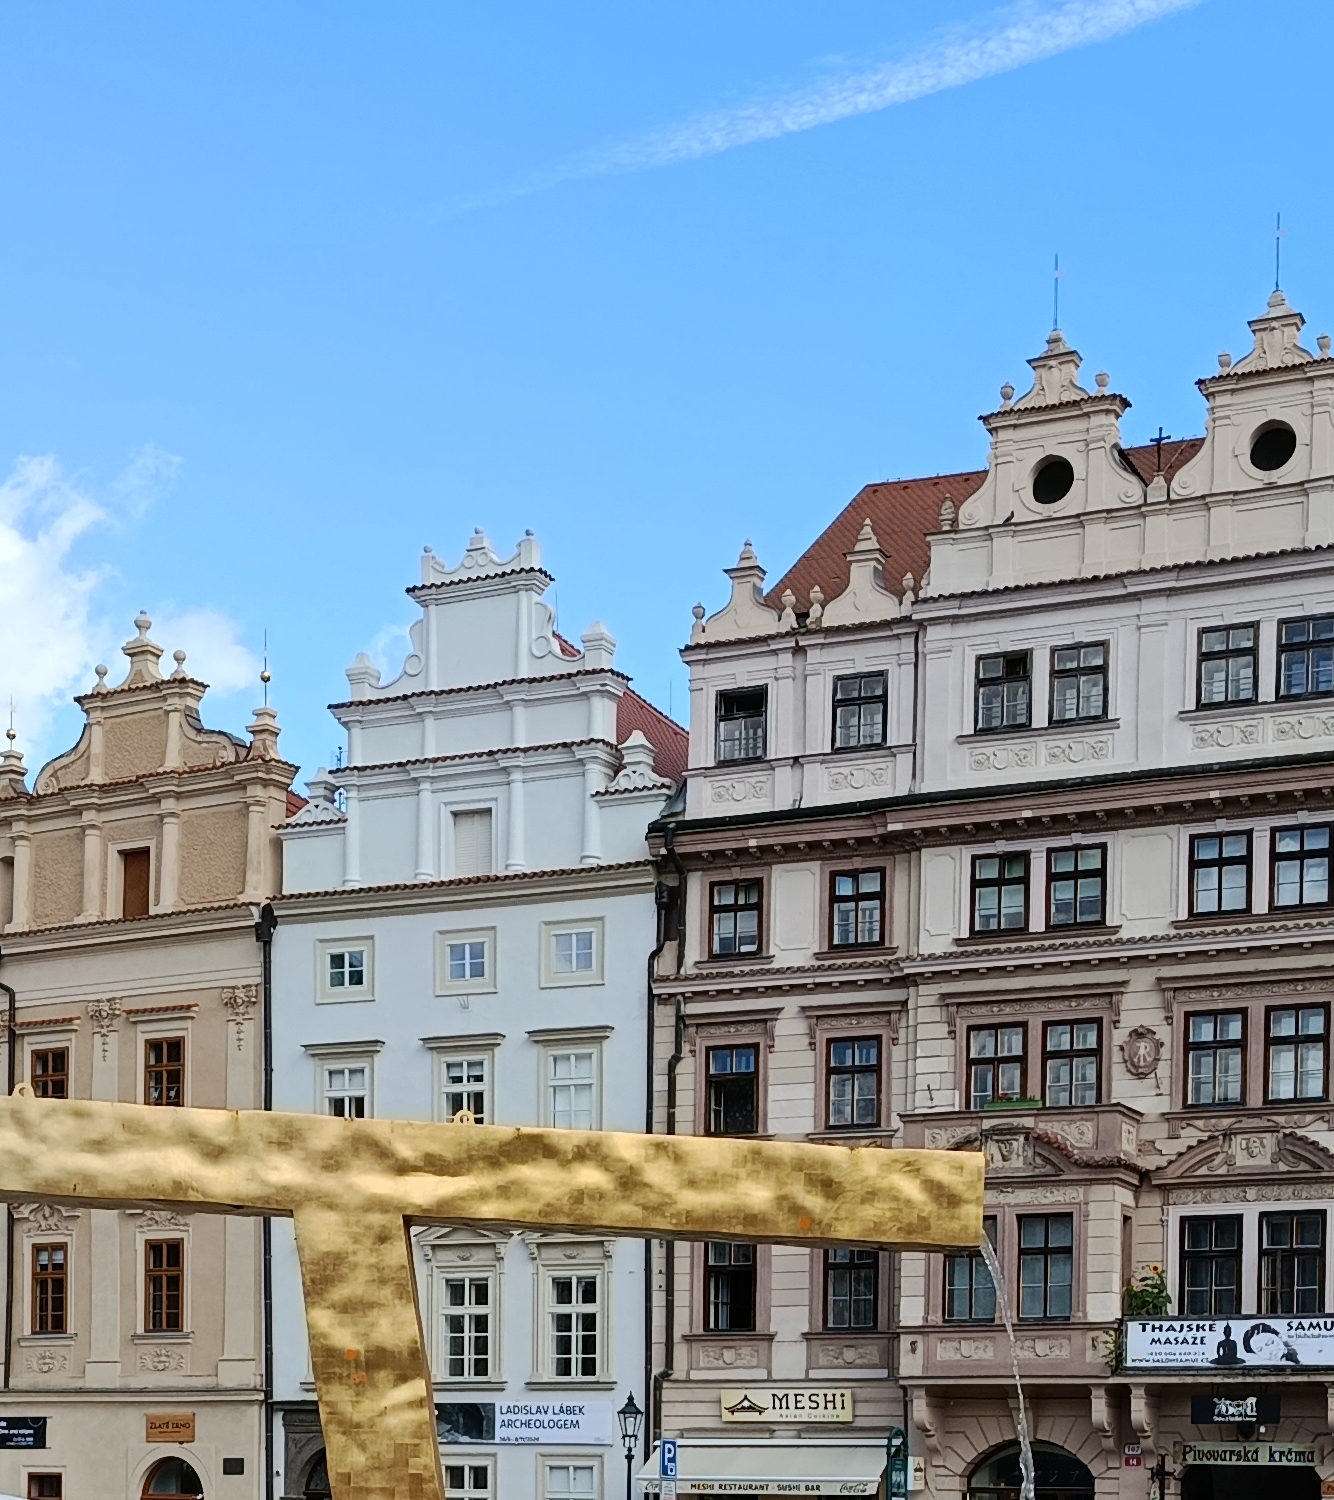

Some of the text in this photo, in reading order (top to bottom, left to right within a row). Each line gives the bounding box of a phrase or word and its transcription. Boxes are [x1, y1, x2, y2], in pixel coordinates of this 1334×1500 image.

[1138, 1320, 1217, 1333] THAJSKÉ
[499, 1402, 585, 1416] LADISLAV LÁBEK
[499, 1418, 580, 1430] ARCHEOLOGEM
[664, 1443, 675, 1466] P
[1181, 1444, 1316, 1463] Pivovarská krčma
[718, 1483, 770, 1492] RESTAURANT
[777, 1483, 801, 1492] SUSHI
[805, 1484, 821, 1492] BAR
